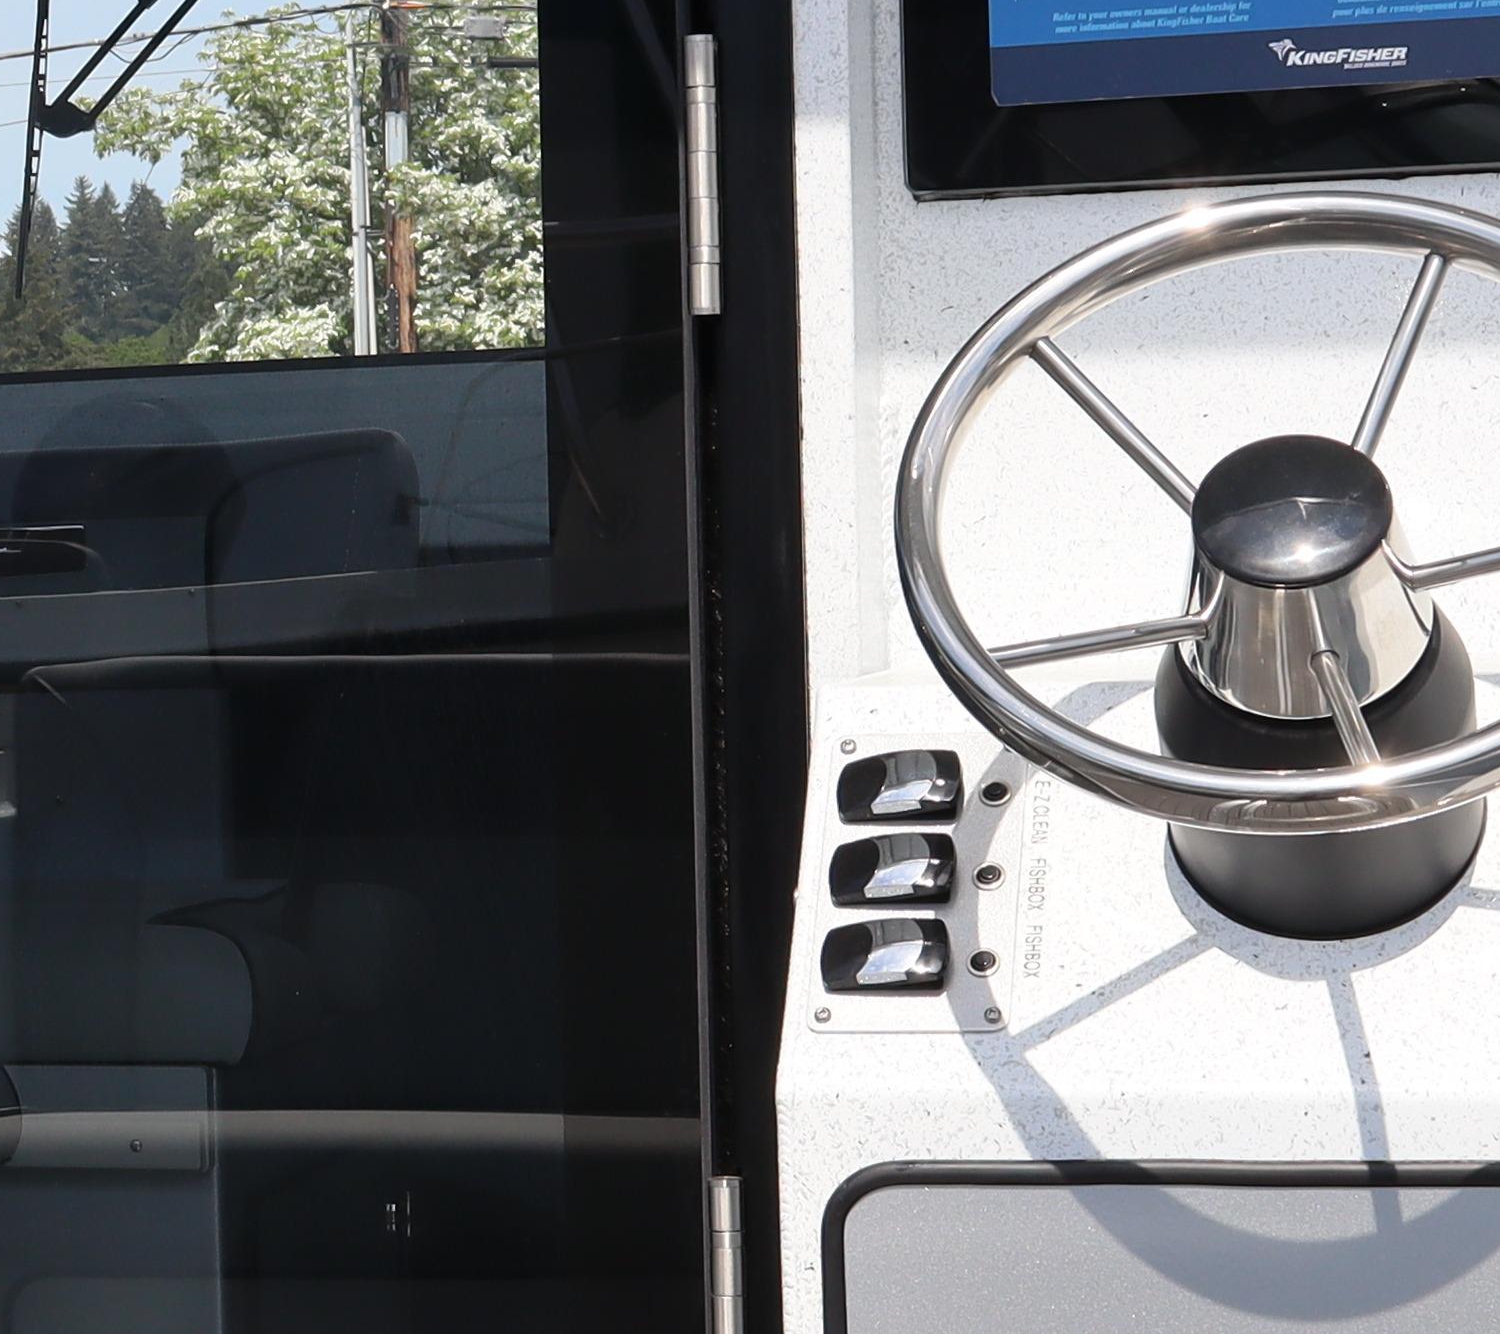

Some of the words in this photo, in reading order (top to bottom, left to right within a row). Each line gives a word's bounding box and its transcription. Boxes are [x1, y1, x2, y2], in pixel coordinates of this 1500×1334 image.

[1033, 780, 1051, 802] E-Z
[1031, 804, 1050, 844] CLEAN
[1027, 858, 1047, 912] FISHBOX
[1023, 925, 1043, 979] FISHBOX
